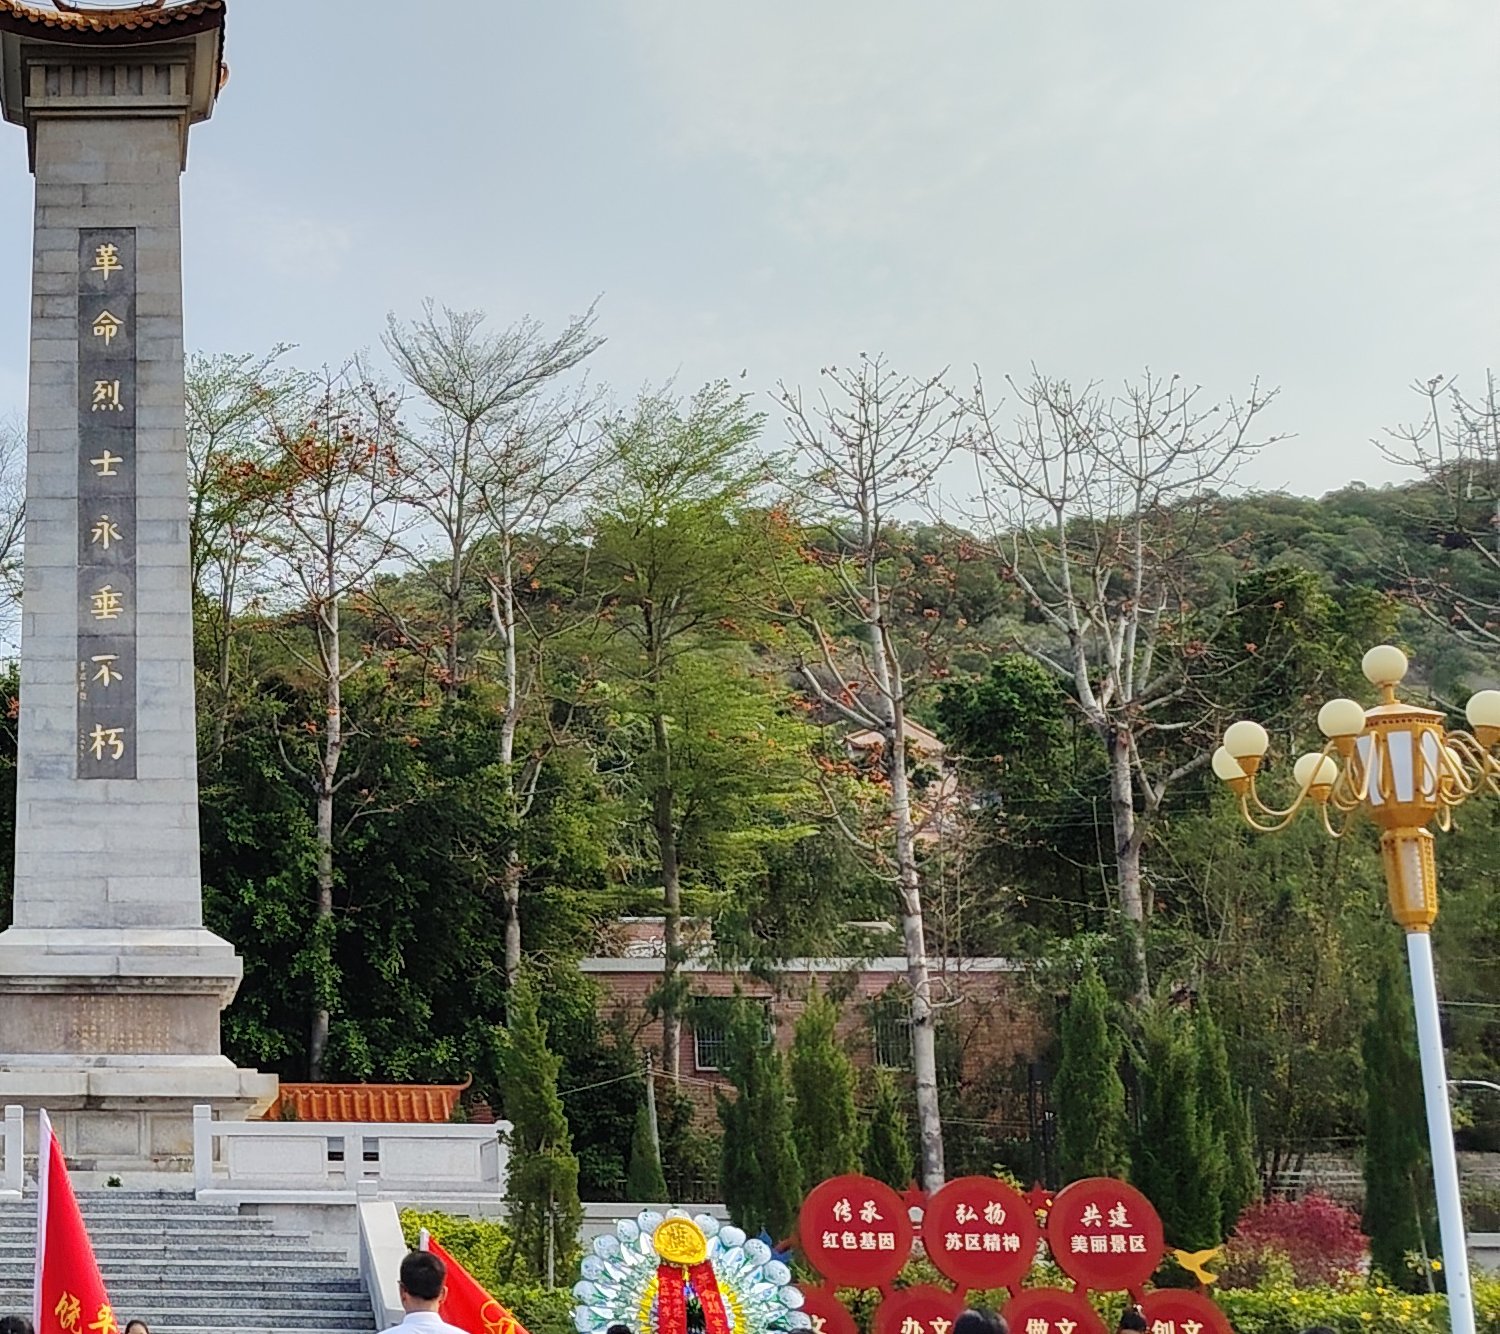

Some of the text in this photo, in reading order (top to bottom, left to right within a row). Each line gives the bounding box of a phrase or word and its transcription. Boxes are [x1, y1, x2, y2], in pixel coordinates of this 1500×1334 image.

[90, 243, 124, 760] 革命烈士永垂不朽
[832, 1198, 884, 1224] 传承
[955, 1201, 1006, 1226] 弘扬
[1080, 1202, 1132, 1229] 共建
[822, 1231, 895, 1252] 红色基因
[944, 1232, 1021, 1254] 苏区精神
[1071, 1234, 1147, 1255] 美丽景区
